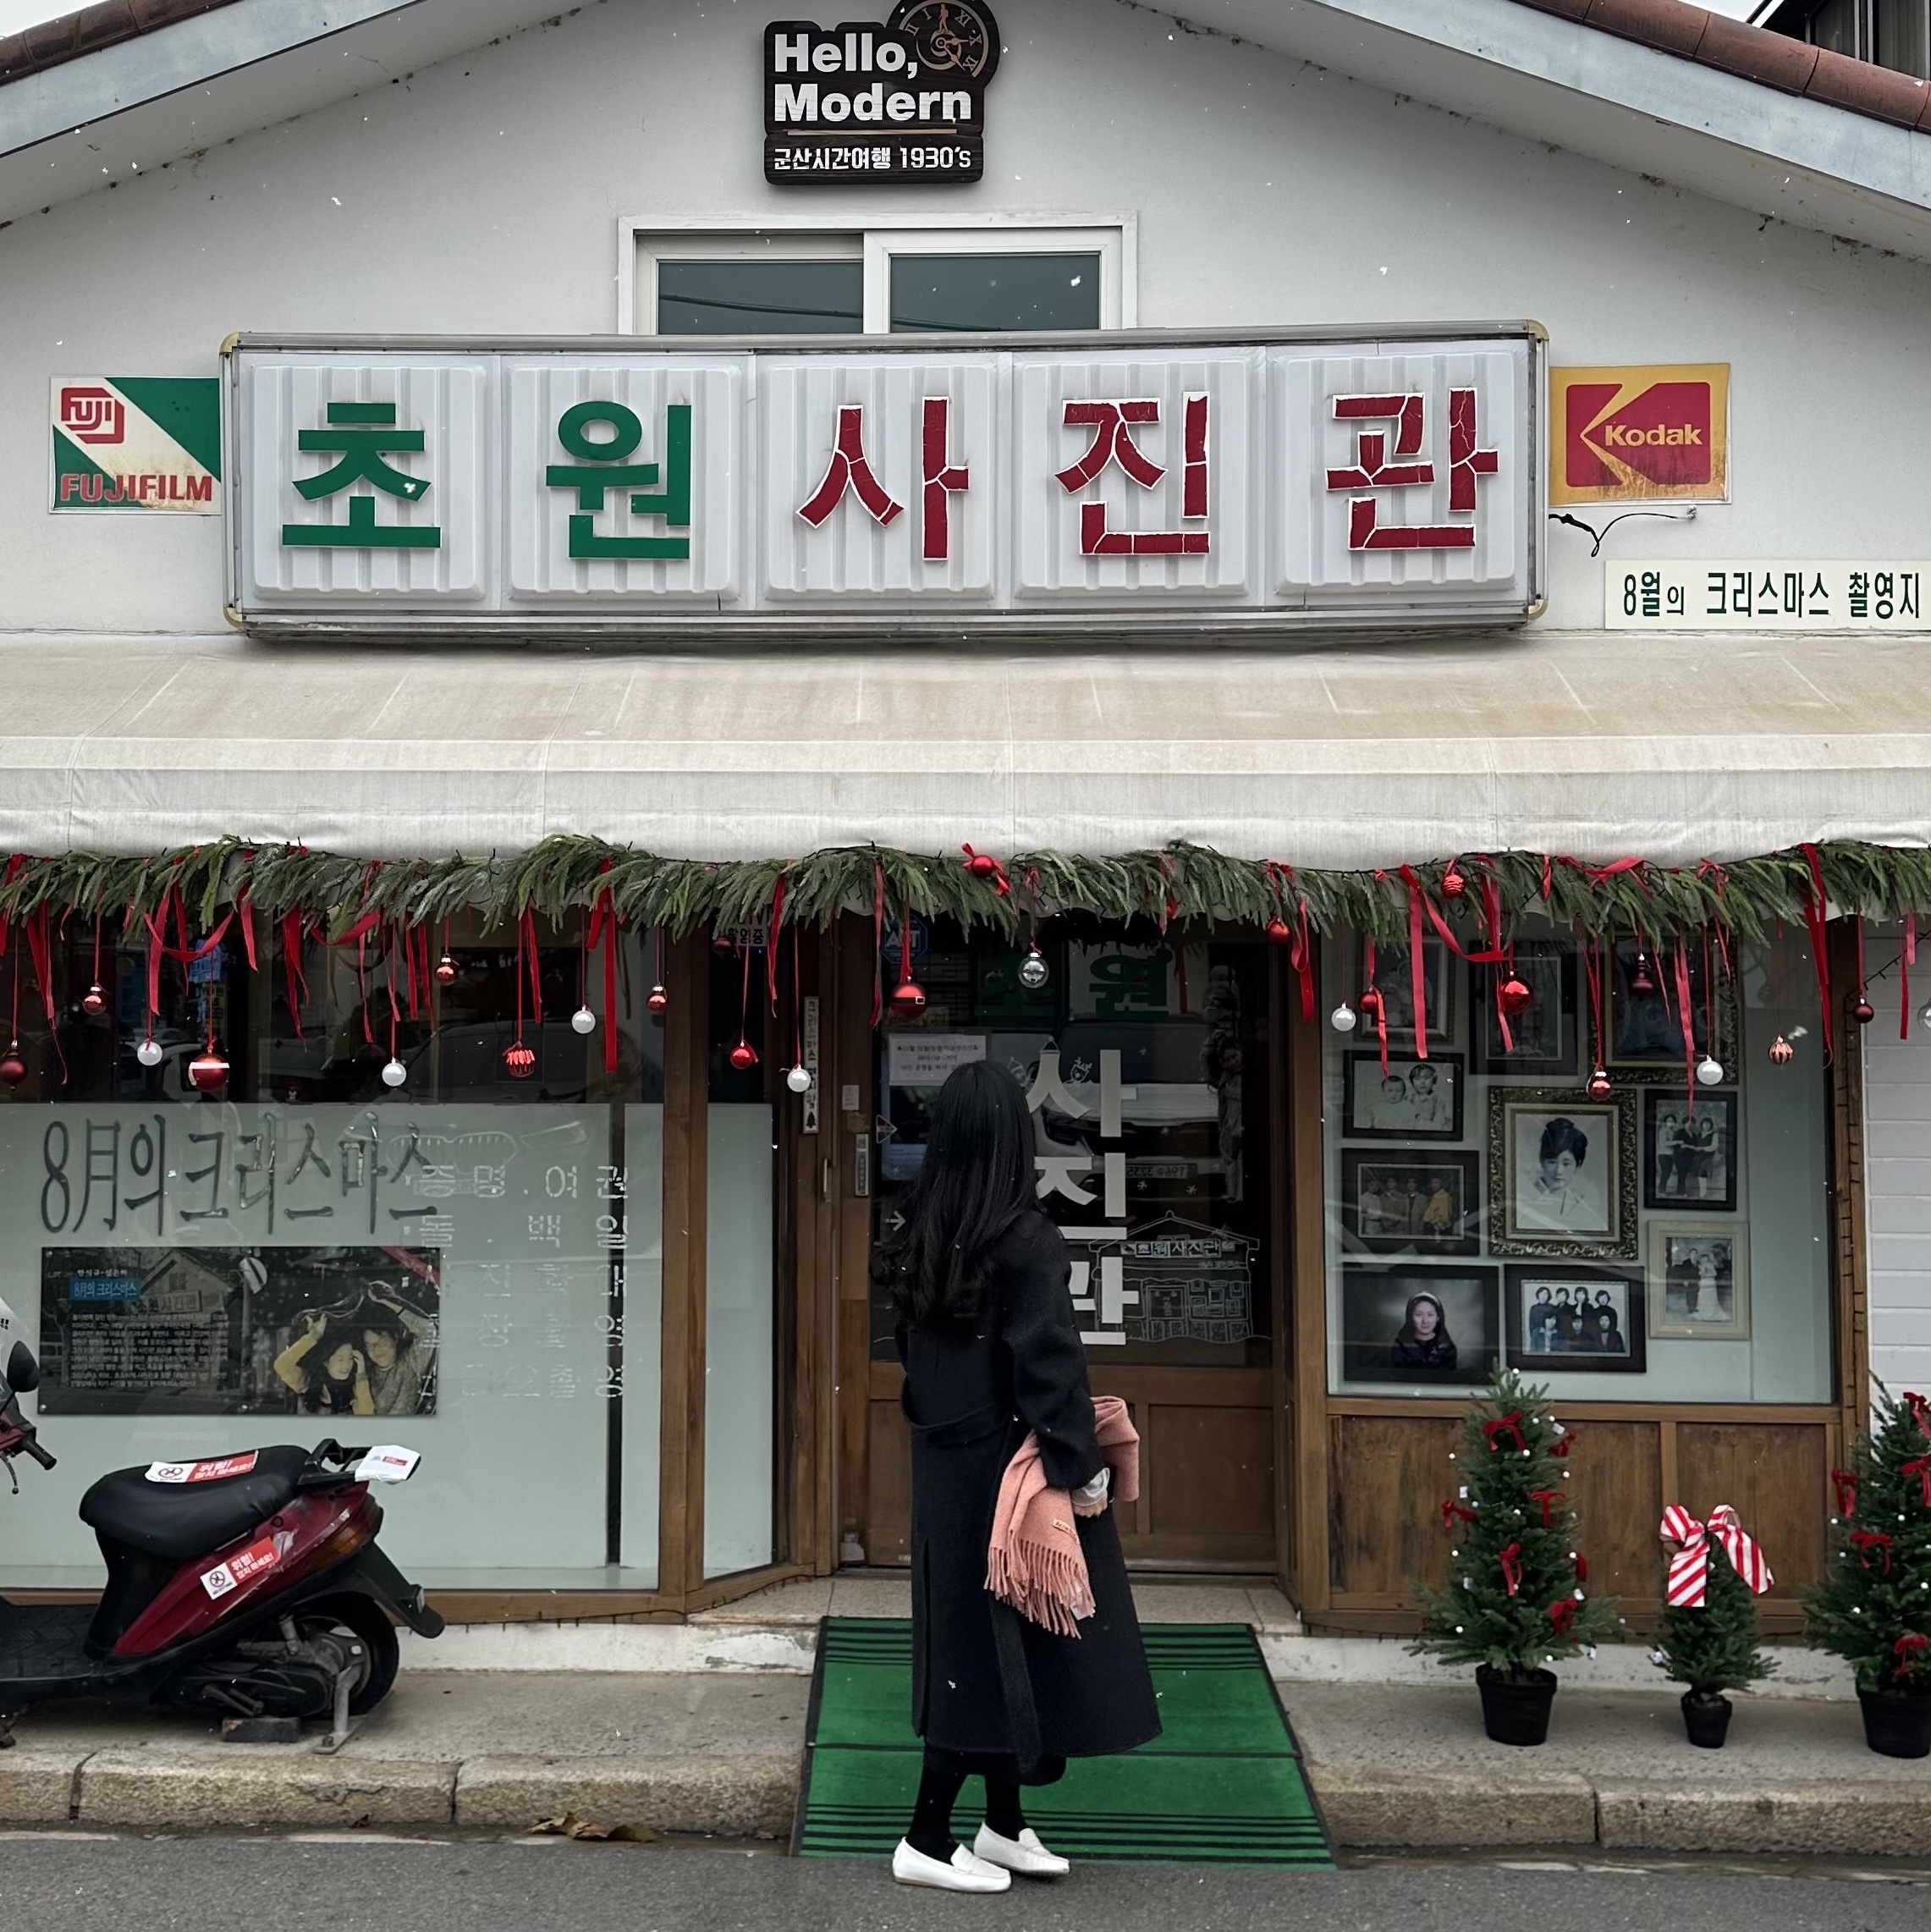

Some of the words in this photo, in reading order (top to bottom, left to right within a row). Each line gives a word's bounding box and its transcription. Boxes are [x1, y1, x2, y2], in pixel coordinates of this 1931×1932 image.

[774, 33, 918, 79] Hello,
[774, 82, 971, 122] Modern
[774, 147, 891, 170] 군산시간여행
[899, 146, 971, 169] 1930's
[63, 391, 121, 438] FUJI
[1604, 423, 1703, 447] Kodak
[60, 473, 212, 502] FUJIFILM
[1624, 571, 1685, 618] 8월의
[1707, 571, 1829, 618] 크리스마스
[1848, 571, 1920, 619] 촬영지
[885, 930, 921, 948] AT
